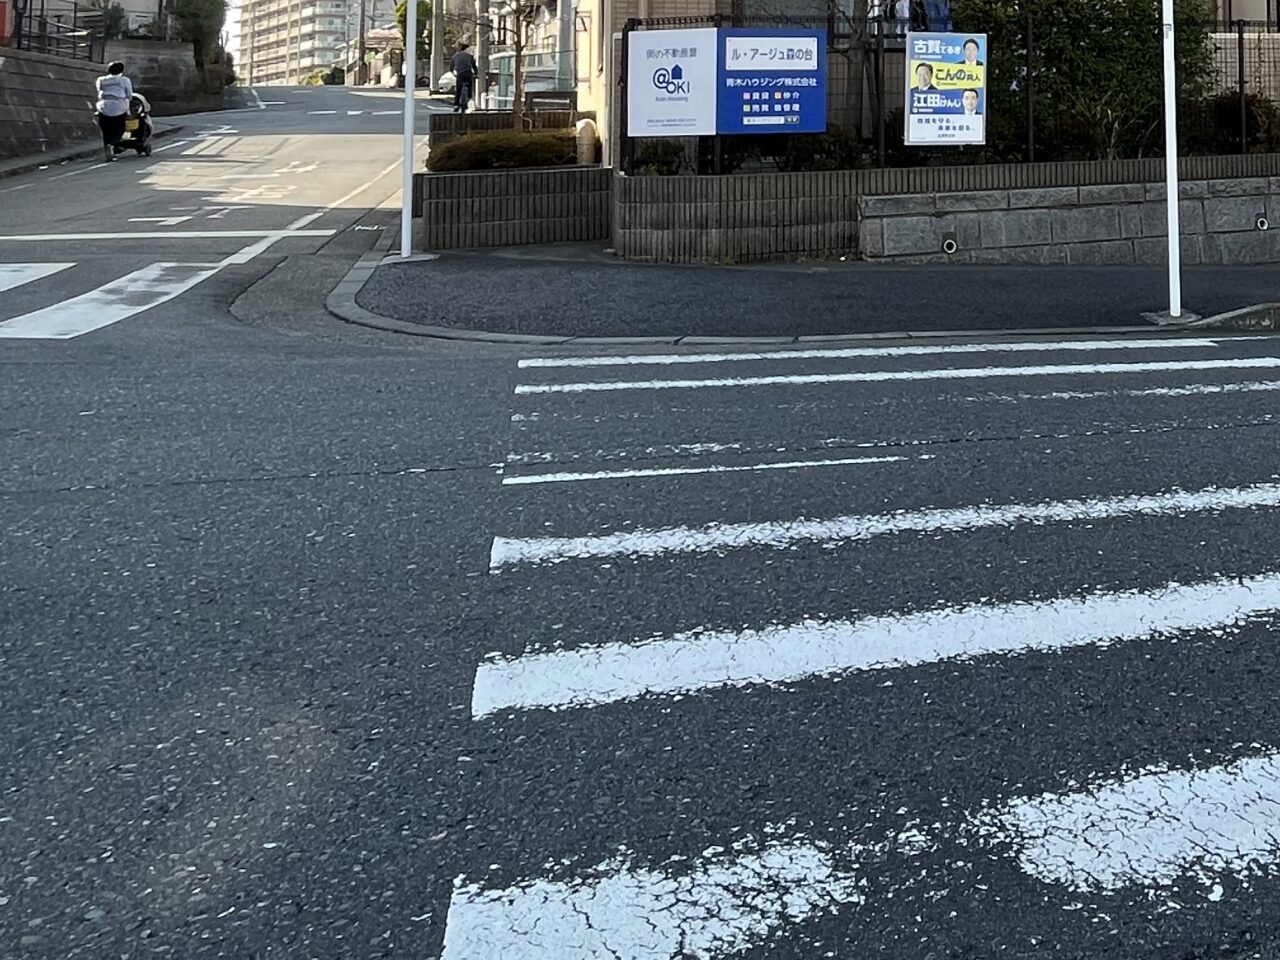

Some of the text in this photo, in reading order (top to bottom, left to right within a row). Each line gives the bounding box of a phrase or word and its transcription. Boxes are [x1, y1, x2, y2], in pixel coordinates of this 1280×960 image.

[731, 48, 813, 61] ル・アージュ森の台
[726, 77, 818, 88] 青木ハウジング株式会社
